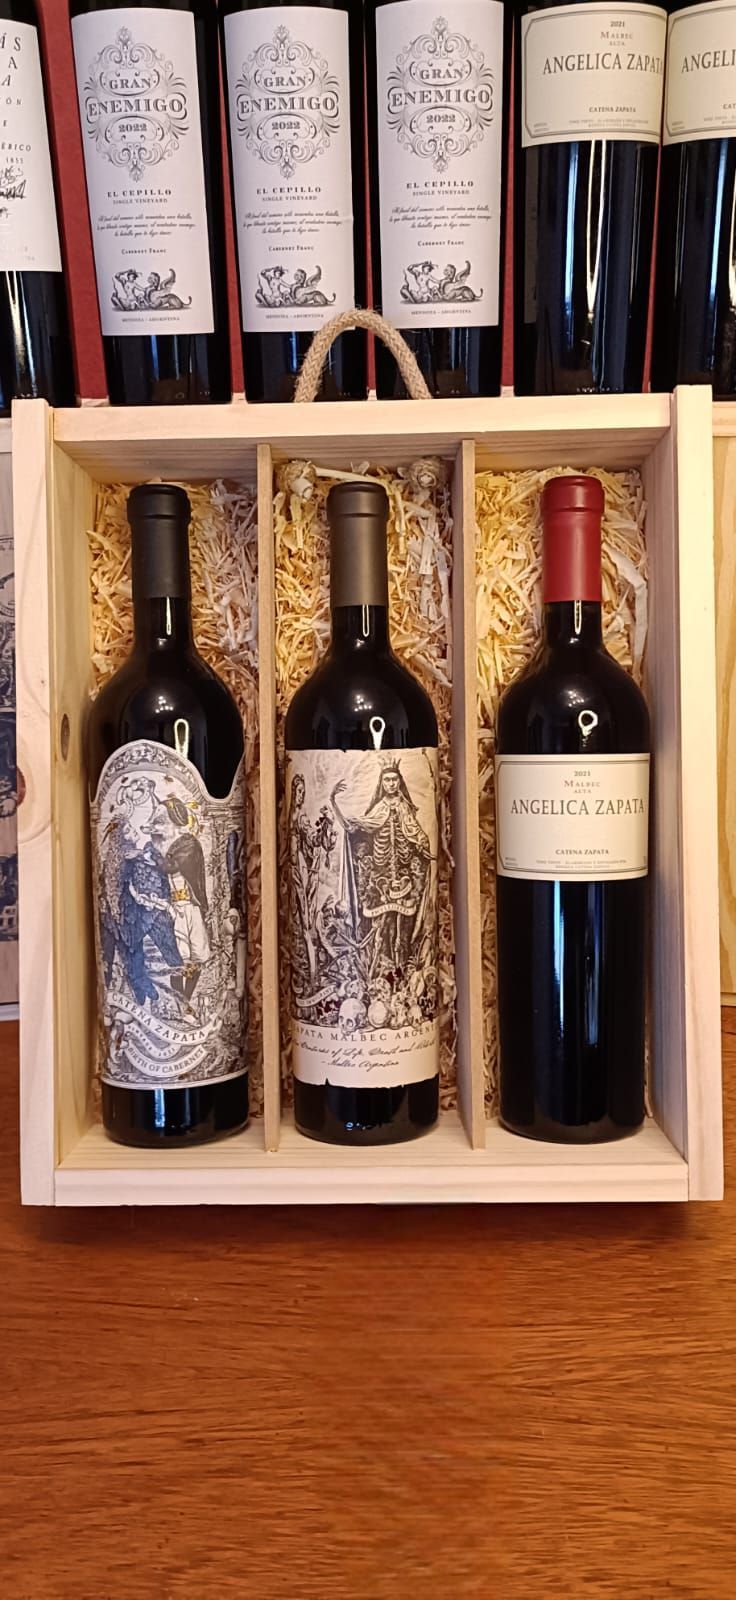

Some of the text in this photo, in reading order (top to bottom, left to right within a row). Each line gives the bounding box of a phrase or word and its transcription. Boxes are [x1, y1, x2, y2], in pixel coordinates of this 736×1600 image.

[610, 20, 625, 28] 2021
[543, 53, 622, 75] ANGELICA
[419, 68, 463, 80] GRAN
[109, 78, 151, 90] GRAN
[263, 76, 306, 87] GRAN
[391, 89, 490, 107] ENEMIGO
[88, 98, 183, 117] ENEMIGO
[240, 96, 336, 114] ENEMIGO
[426, 114, 456, 123] 2022
[118, 123, 147, 132] 2022
[271, 121, 301, 130] 2022
[122, 189, 172, 197] CEPILLO
[272, 186, 321, 194] CEPILLO
[510, 798, 645, 815] ANGELICA ZAPATA
[112, 993, 152, 1027] CATENA
[154, 1024, 206, 1042] ZAPATA
[330, 1032, 387, 1042] MALBEC
[331, 1047, 343, 1058] of
[398, 1042, 416, 1053] and
[128, 1047, 204, 1073] BIRTH OF CABERNET
